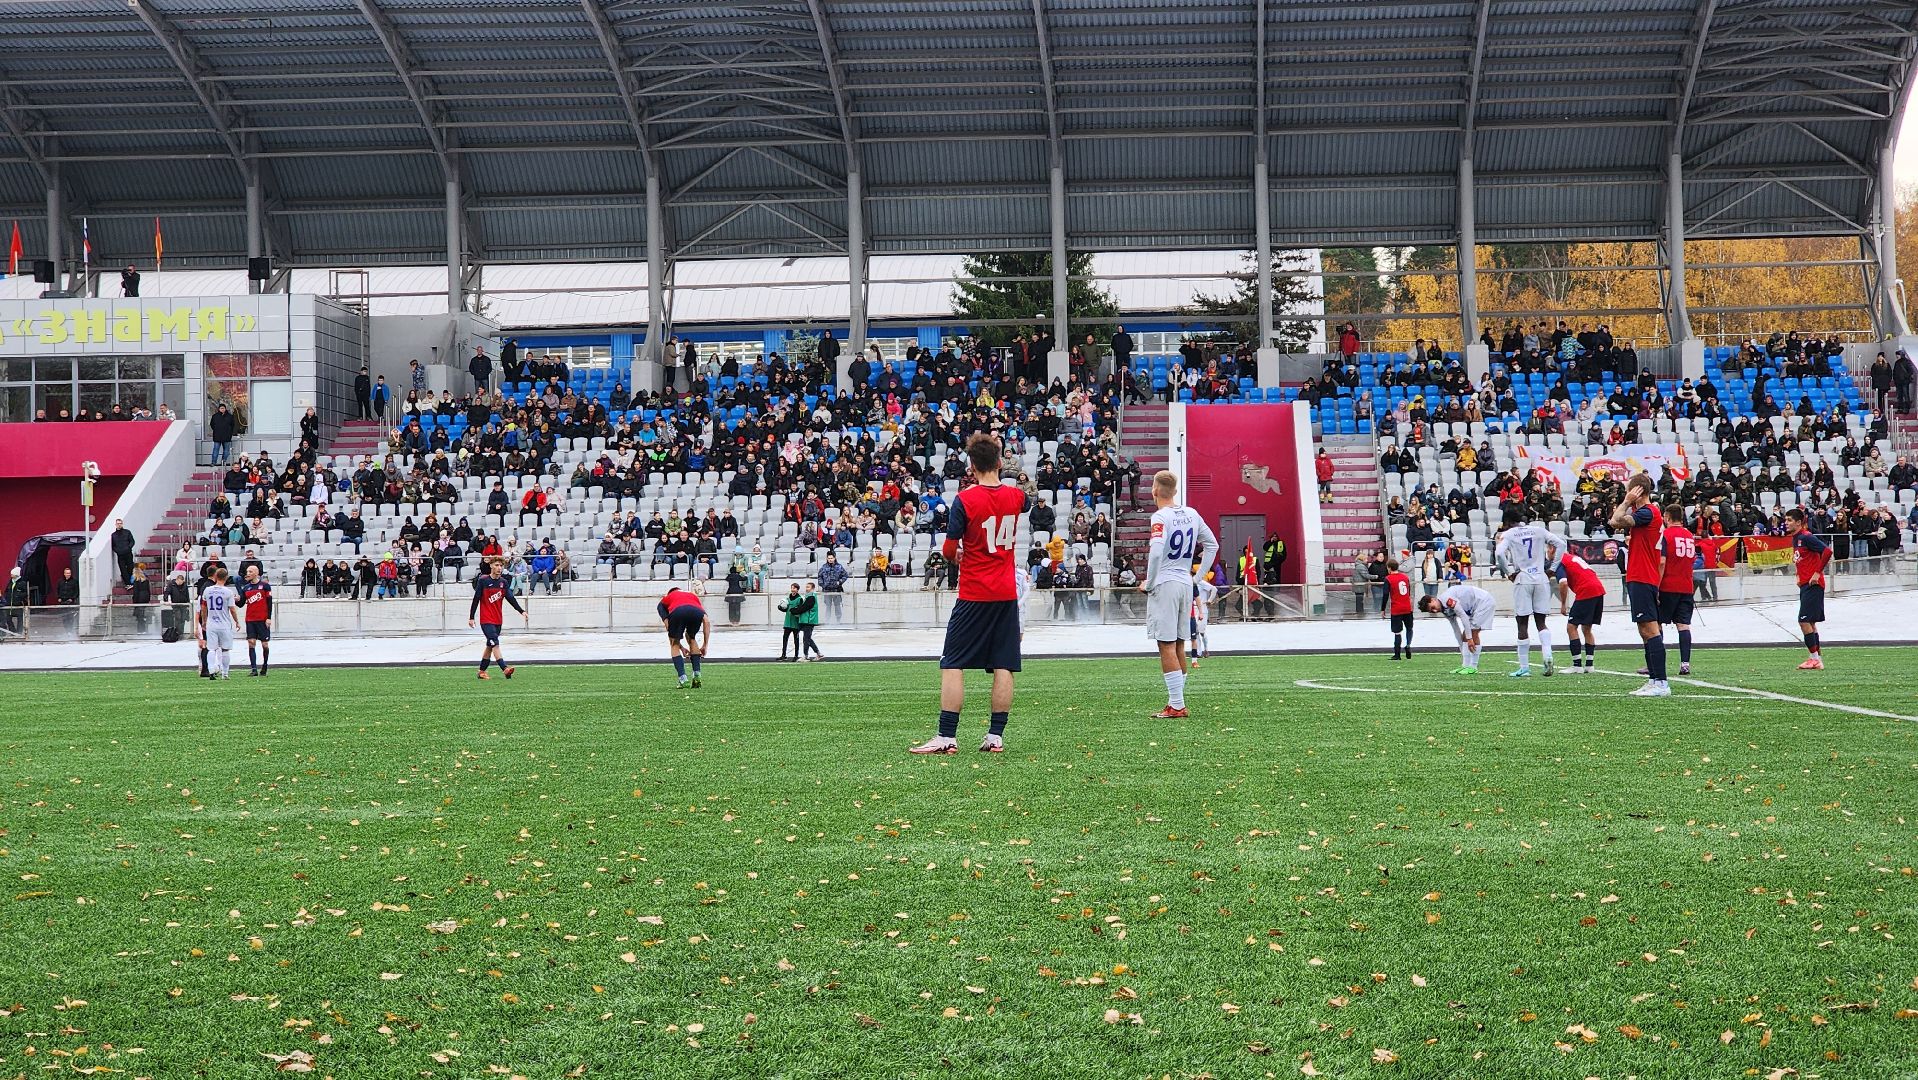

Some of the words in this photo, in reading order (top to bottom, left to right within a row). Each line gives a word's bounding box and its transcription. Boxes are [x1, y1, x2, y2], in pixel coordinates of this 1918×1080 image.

[981, 514, 1016, 554] 14
[1167, 527, 1194, 560] 91
[1521, 537, 1533, 559] 7
[1674, 537, 1696, 558] 55
[1398, 580, 1408, 596] 6
[208, 595, 225, 611] 19
